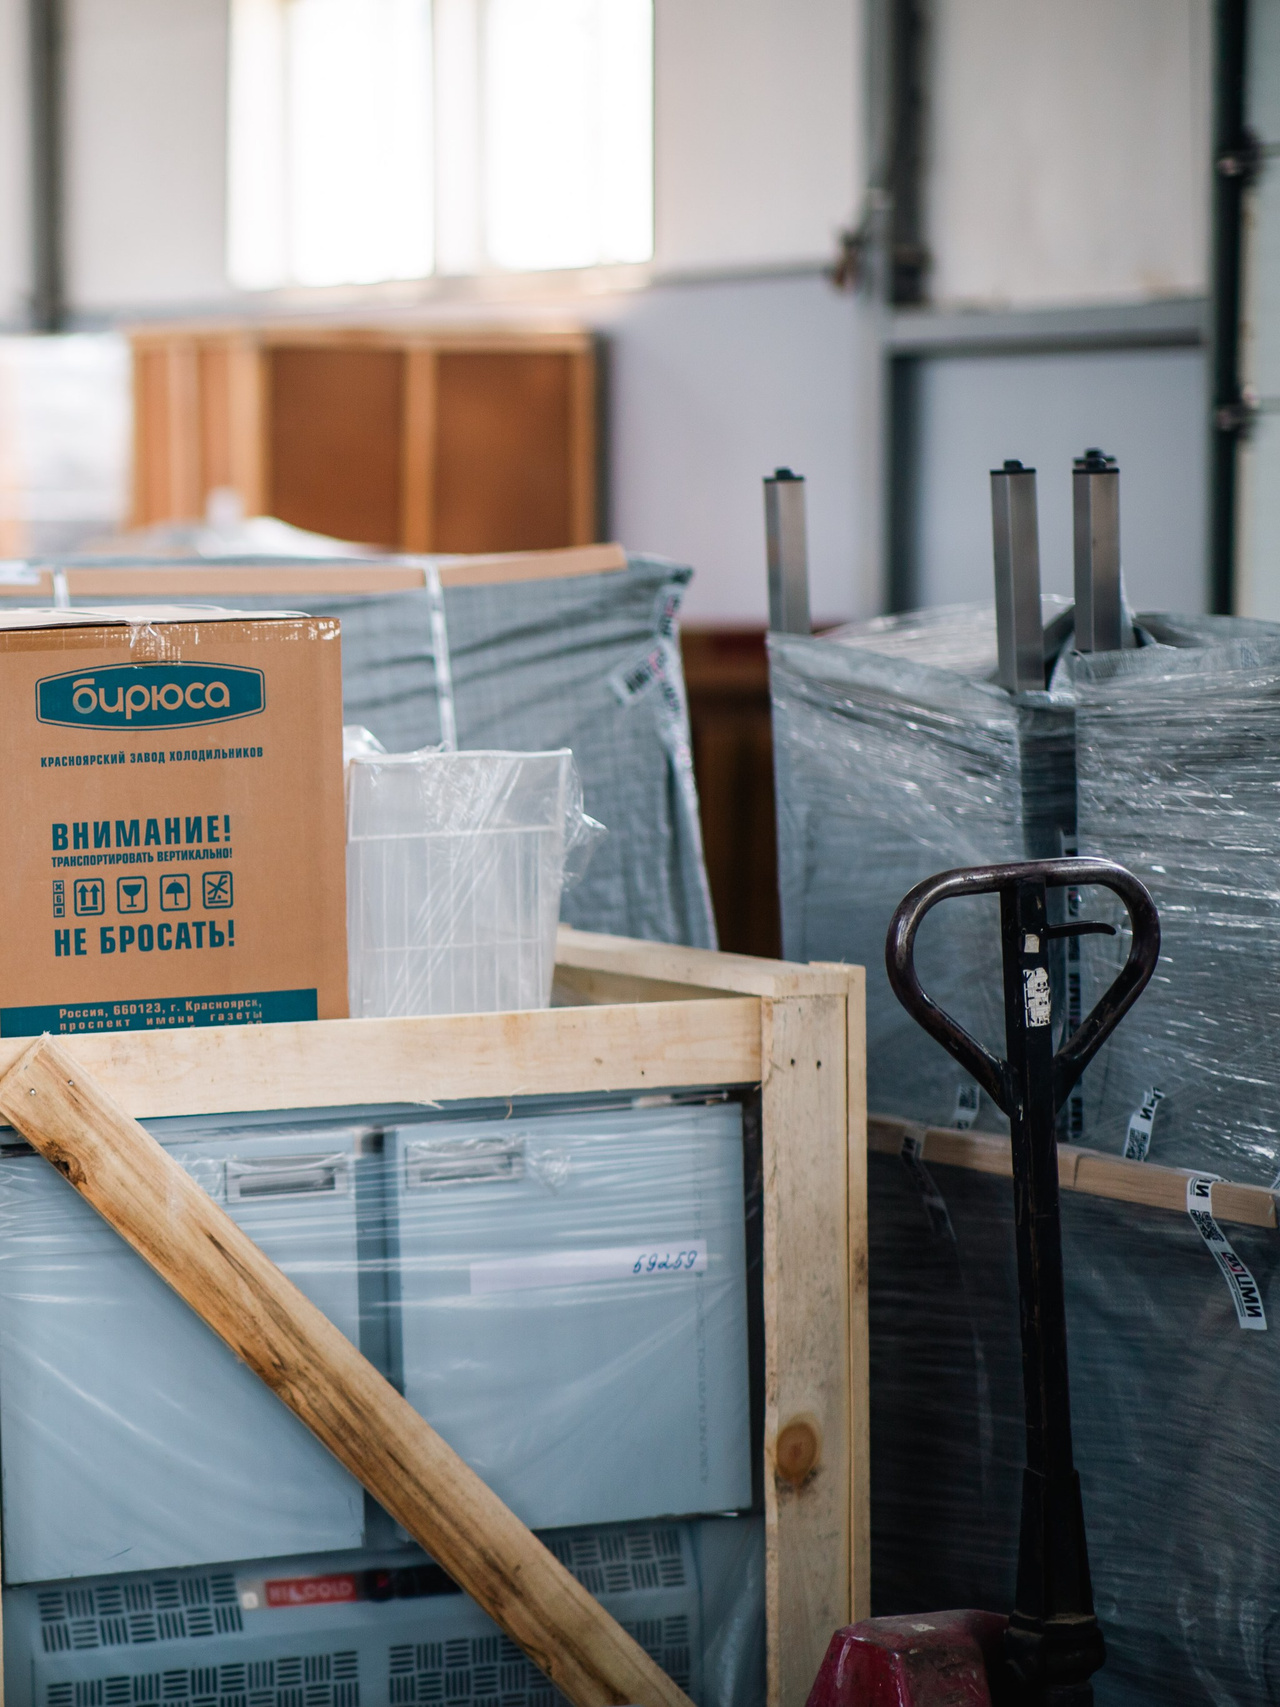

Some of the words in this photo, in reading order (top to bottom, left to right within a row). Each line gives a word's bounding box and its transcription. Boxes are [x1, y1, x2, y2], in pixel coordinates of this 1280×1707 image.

[72, 678, 230, 720] бирюса
[40, 751, 126, 768] КРАСНОЯРСКИЙ
[129, 749, 166, 765] ЗАВОД
[169, 746, 264, 763] ХОЛОДИЛЬНИКОВ
[52, 815, 231, 851] ВНИМАНИЕ!
[51, 851, 155, 868] ТРАНСПОРТИРОВАТЬ
[156, 848, 233, 864] ВЕРТИКАЛЬНО!
[54, 927, 87, 957] НЕ
[100, 920, 235, 954] БРОСАТЬ!
[59, 1008, 109, 1020] Россия,
[113, 1002, 166, 1016] 660123,
[170, 1003, 181, 1013] г.
[185, 998, 263, 1012] Красноярск,
[59, 1018, 131, 1032] проспект
[146, 1014, 195, 1026] имени
[210, 1010, 263, 1023] газеты
